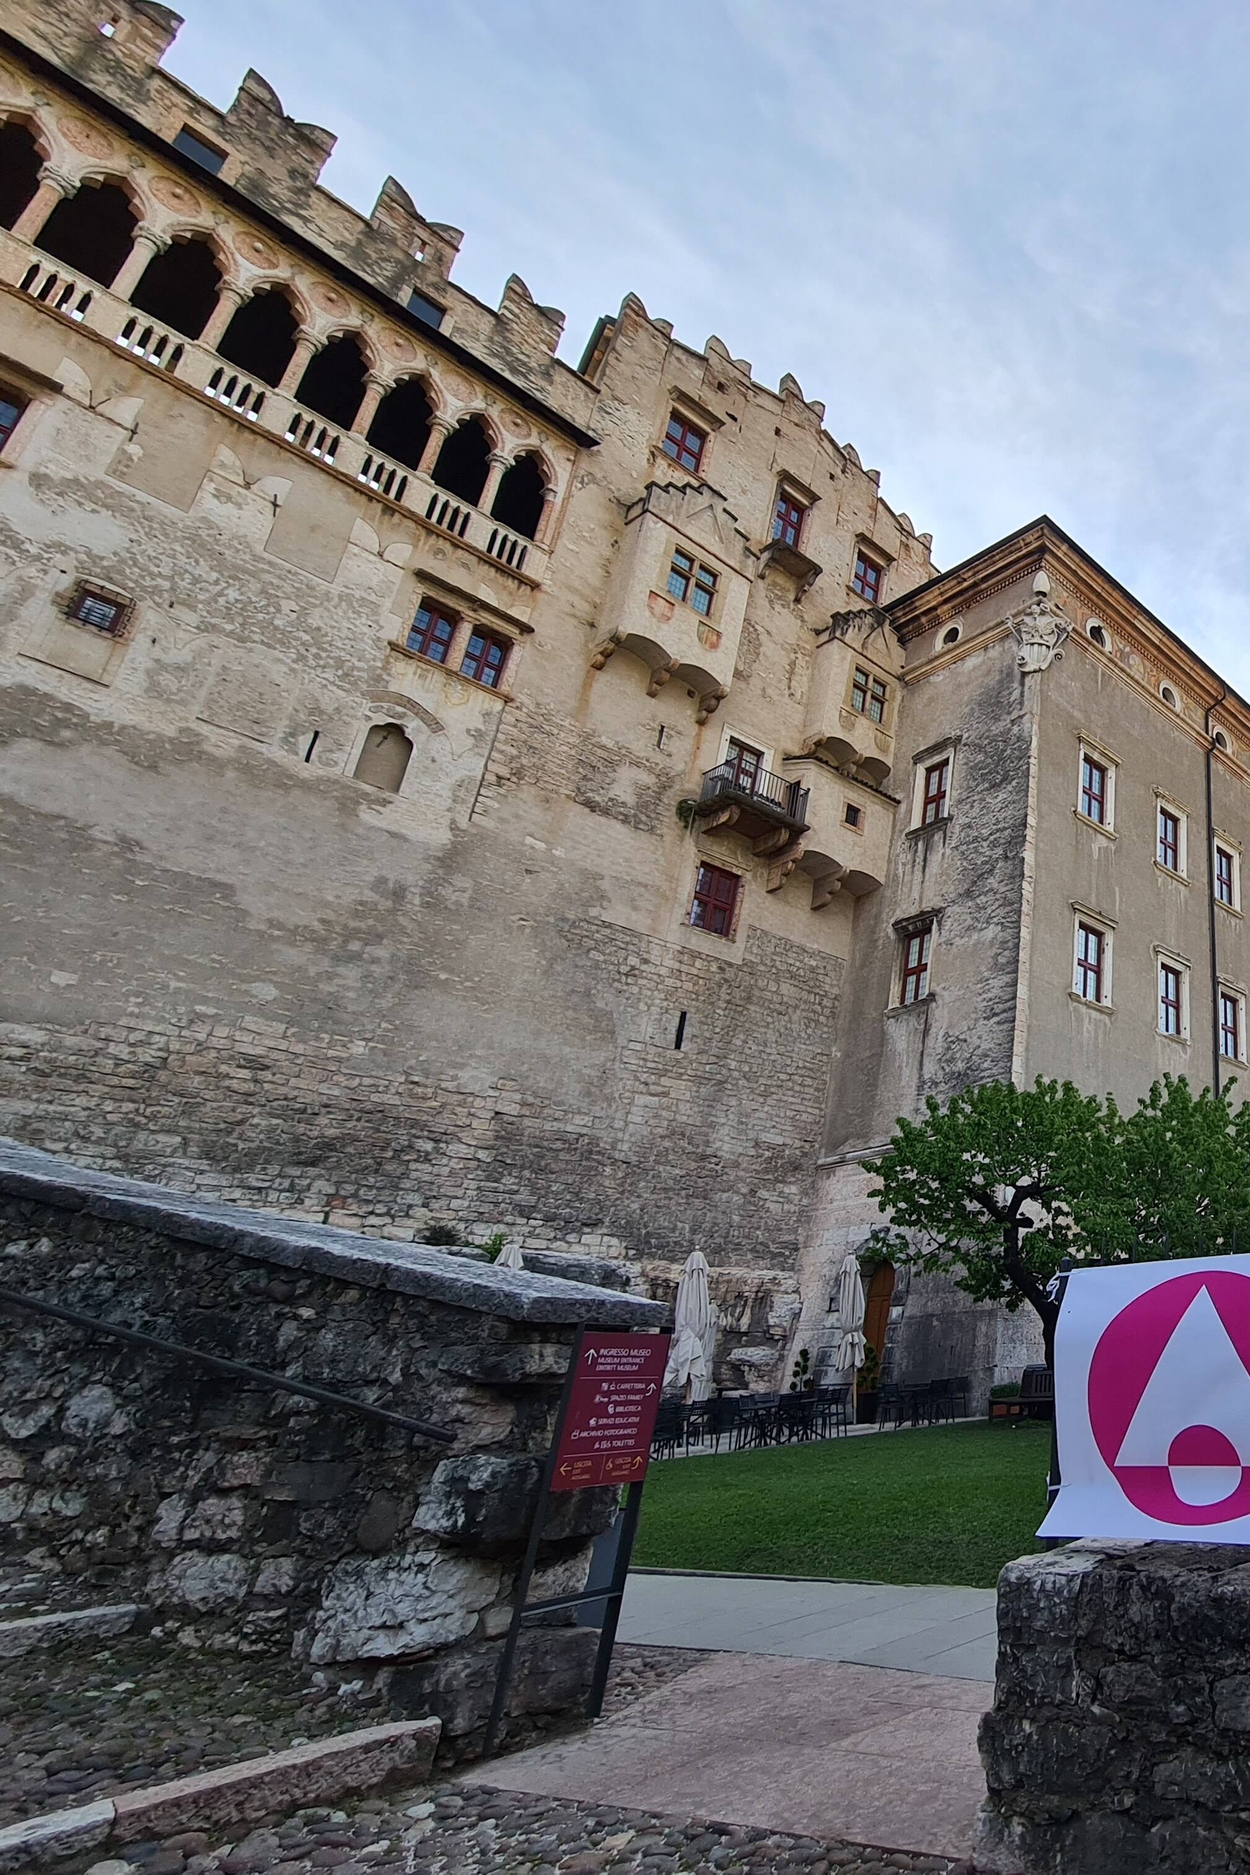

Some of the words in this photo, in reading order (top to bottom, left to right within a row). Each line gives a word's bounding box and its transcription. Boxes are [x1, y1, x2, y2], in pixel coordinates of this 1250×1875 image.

[599, 1348, 630, 1356] INGRESSO
[630, 1348, 652, 1357] MUSEO
[616, 1382, 646, 1390] CAFFETTERIA
[610, 1394, 627, 1402] SPAZIO
[615, 1405, 642, 1413] BIBLIOTECA
[597, 1417, 615, 1425] SERVIZI
[579, 1429, 604, 1438] ARCHIVIO
[603, 1427, 638, 1436] FOTOGRAFICO
[573, 1460, 592, 1468] USCITA
